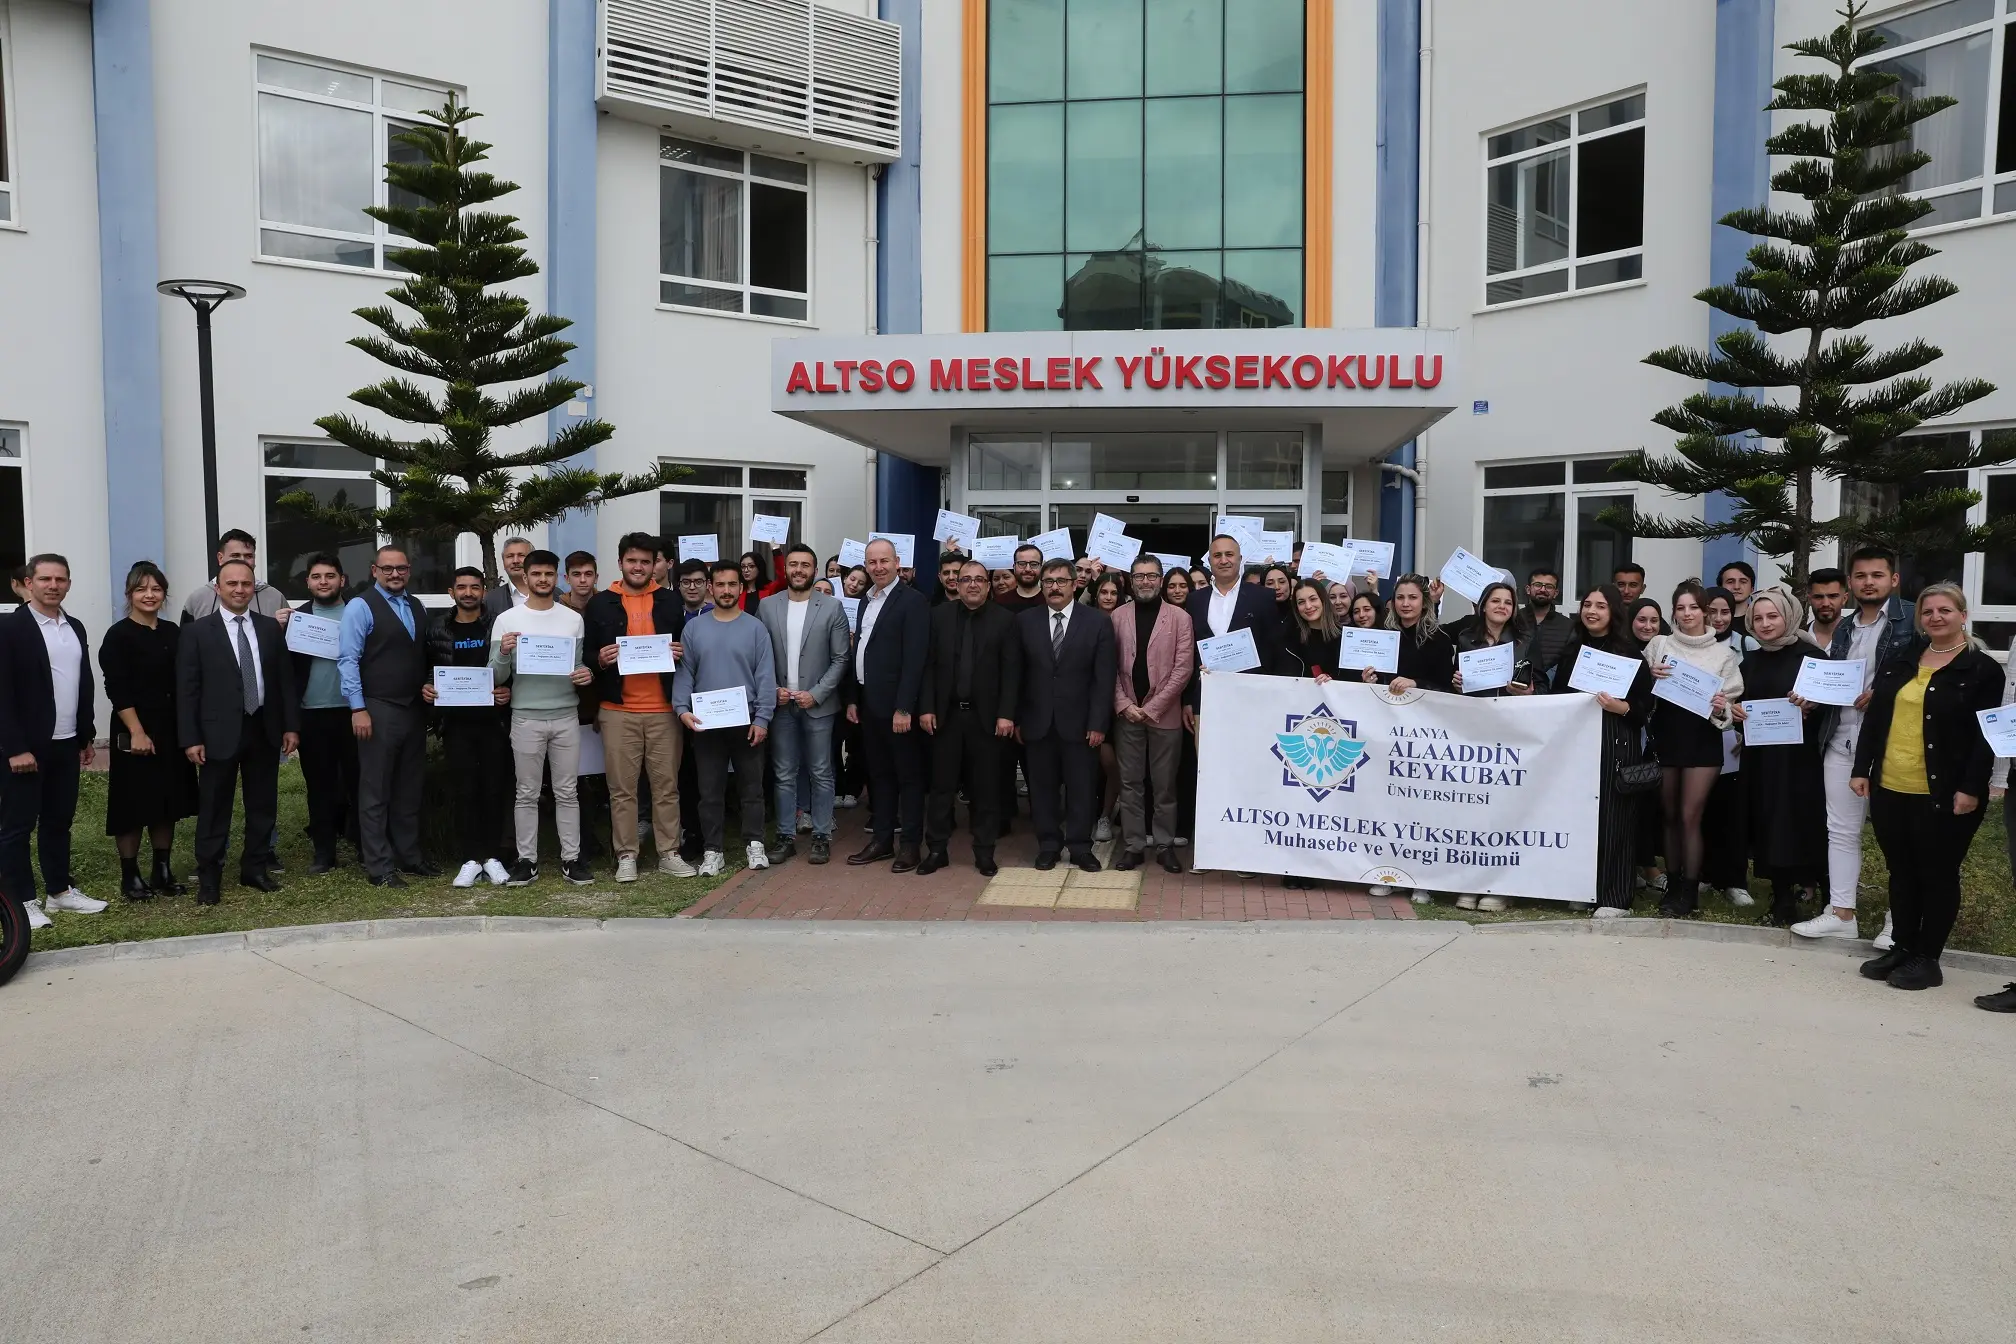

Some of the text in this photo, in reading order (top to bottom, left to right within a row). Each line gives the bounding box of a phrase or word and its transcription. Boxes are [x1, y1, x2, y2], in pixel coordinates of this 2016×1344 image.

[786, 347, 1443, 393] ALTSO MESLEK YÜKSEKOKULU
[454, 637, 484, 649] miav
[1389, 726, 1449, 741] ALANYA
[1388, 741, 1521, 767] ALAADDİN
[1388, 759, 1527, 787] KEYKUBAT
[1386, 785, 1491, 805] ÜNİVERSİTESİ
[1220, 807, 1570, 849] ALTSO MESLEK YÜKSEKOKULU
[1264, 829, 1521, 868] Muhasebe ve Vergi Bölümü
